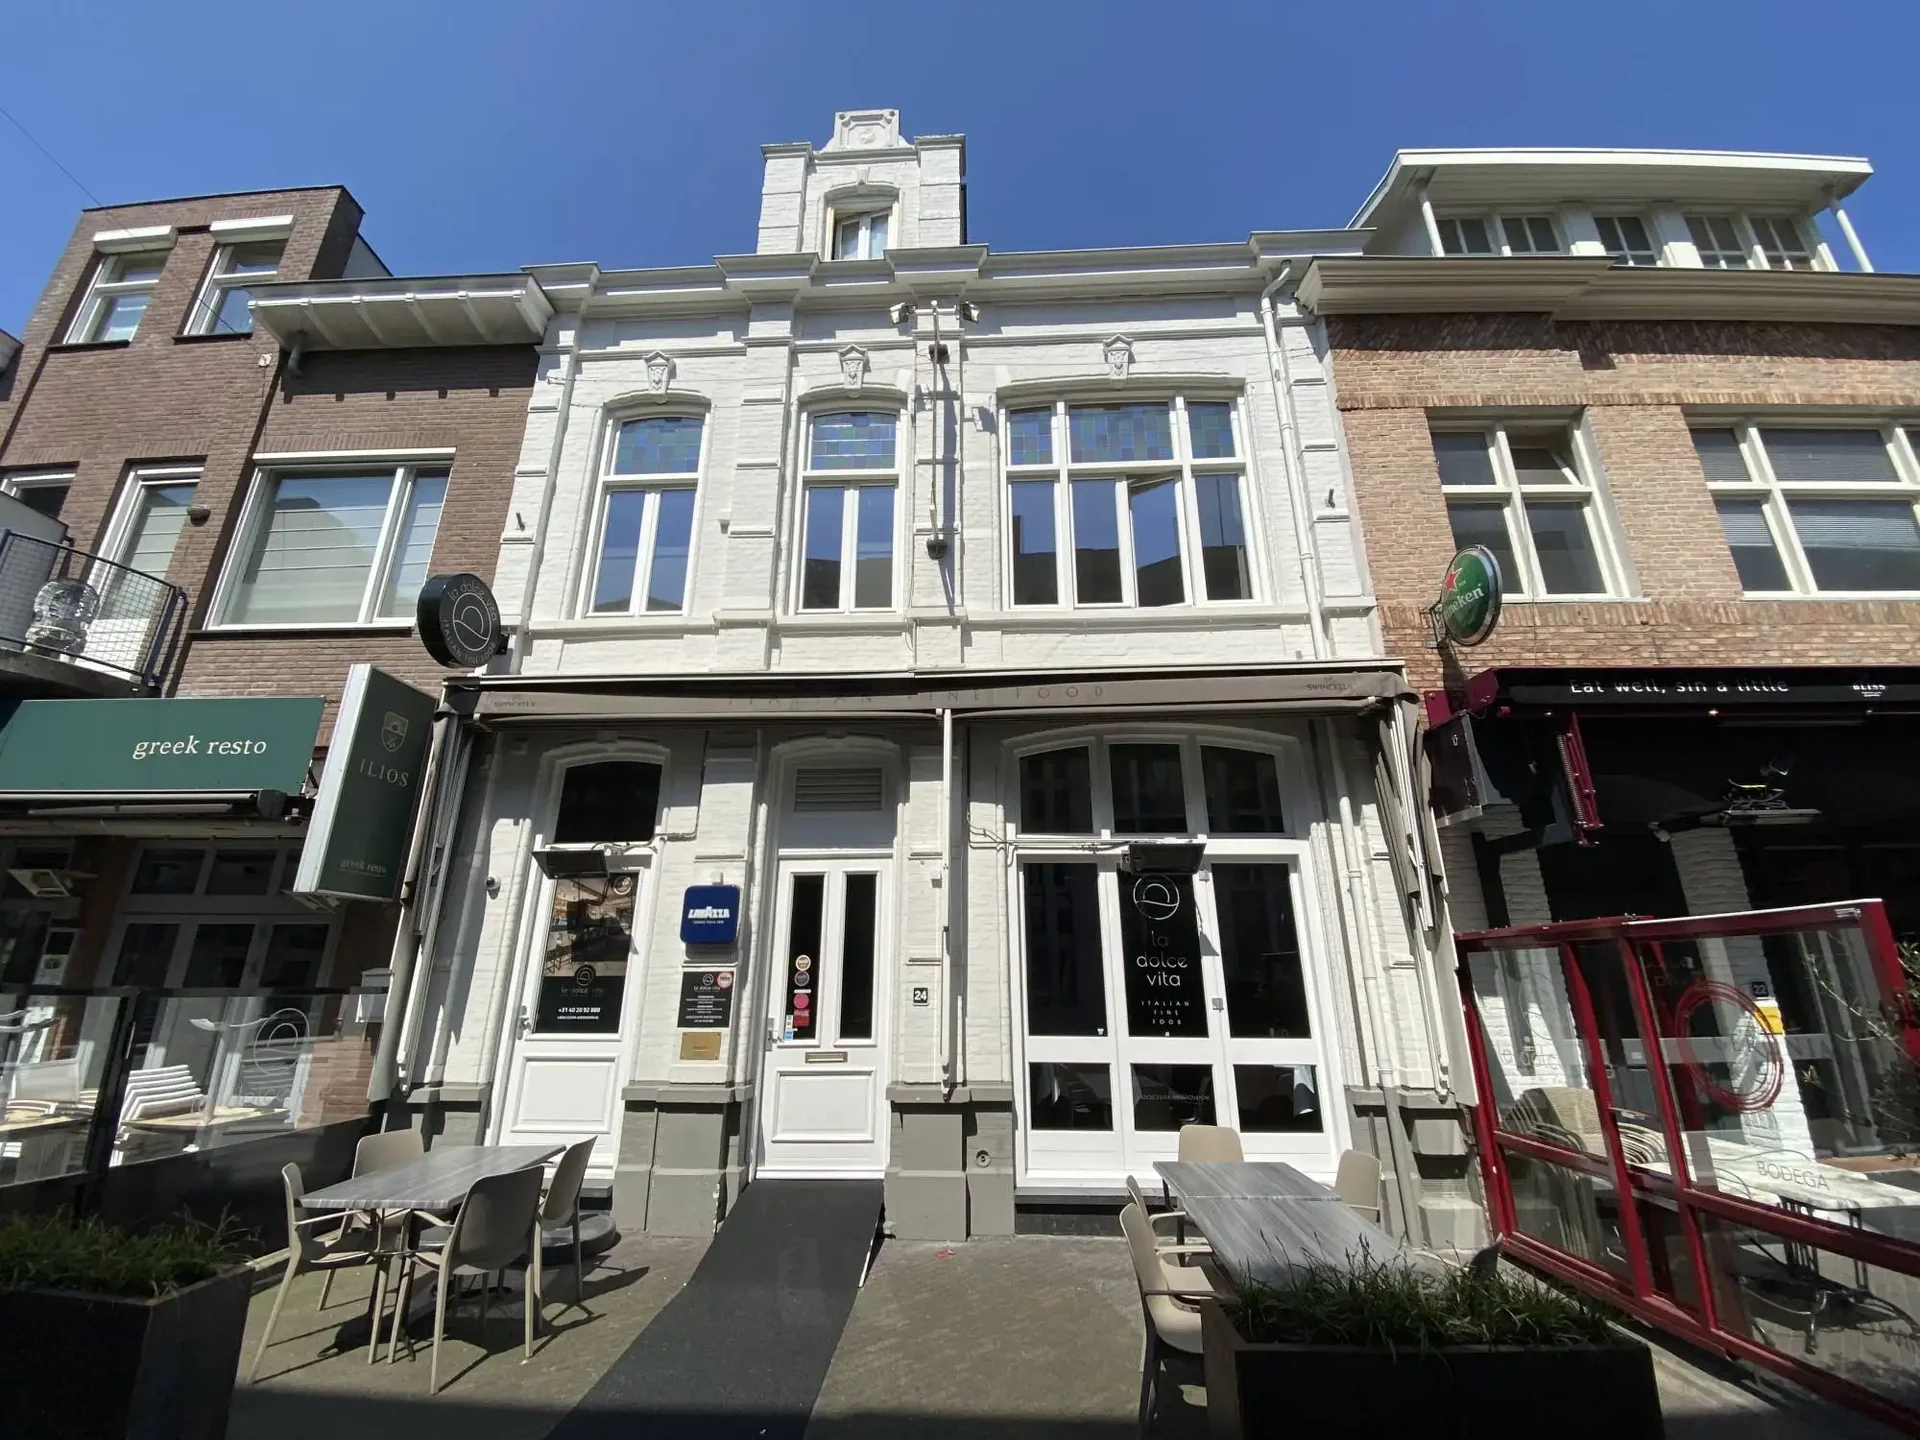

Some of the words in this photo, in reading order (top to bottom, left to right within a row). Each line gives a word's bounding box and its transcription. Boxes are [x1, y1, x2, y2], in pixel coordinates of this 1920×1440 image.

[460, 576, 485, 599] dolce
[486, 598, 499, 622] vita
[1016, 686, 1104, 700] FOOD
[1569, 680, 1604, 693] Eat
[1676, 681, 1707, 692] sin
[132, 735, 200, 760] greek
[206, 739, 267, 755] resto
[359, 758, 409, 787] ILIOS
[1152, 930, 1168, 948] la
[1136, 951, 1188, 968] dolce
[1147, 971, 1181, 987] vita
[914, 990, 927, 1001] 24
[1757, 1160, 1830, 1191] BODEGA
